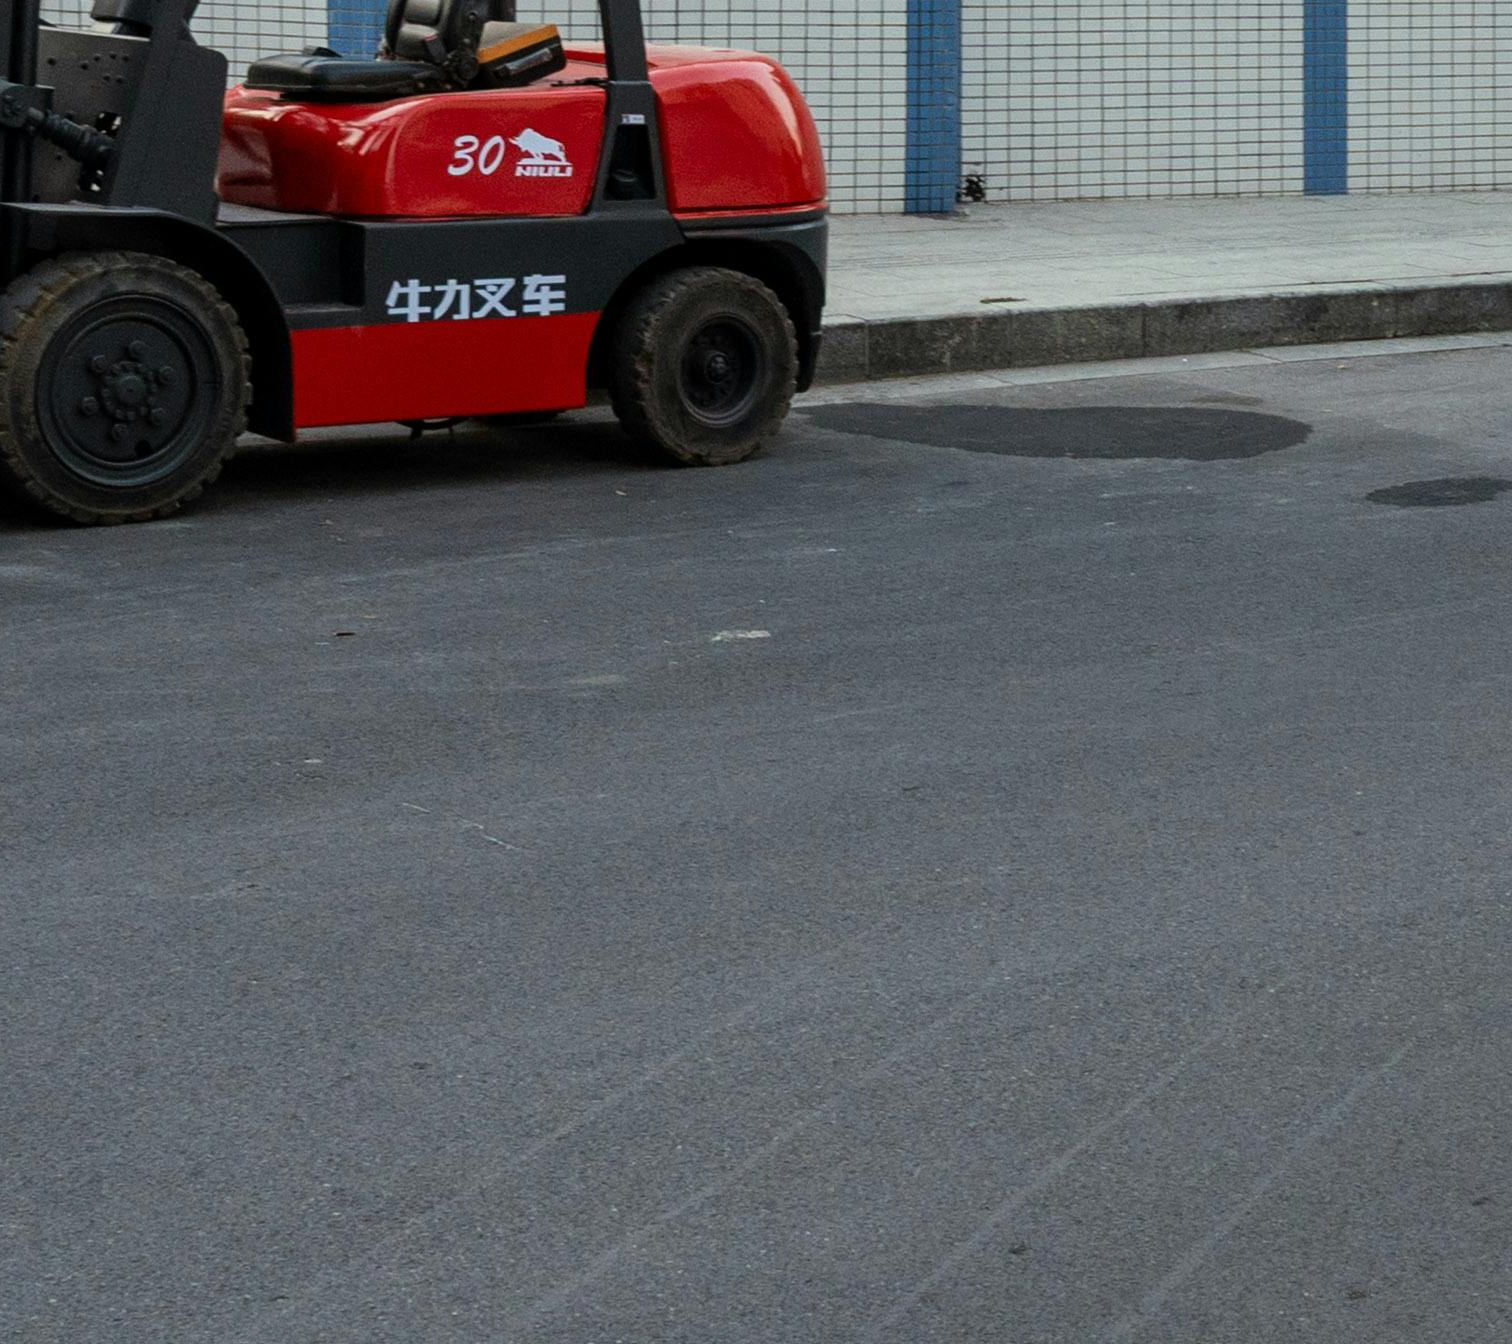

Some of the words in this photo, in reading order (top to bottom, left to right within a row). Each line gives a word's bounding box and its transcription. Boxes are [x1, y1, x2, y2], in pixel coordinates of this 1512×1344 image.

[447, 135, 505, 177] 30
[386, 274, 566, 323] 牛力叉车
